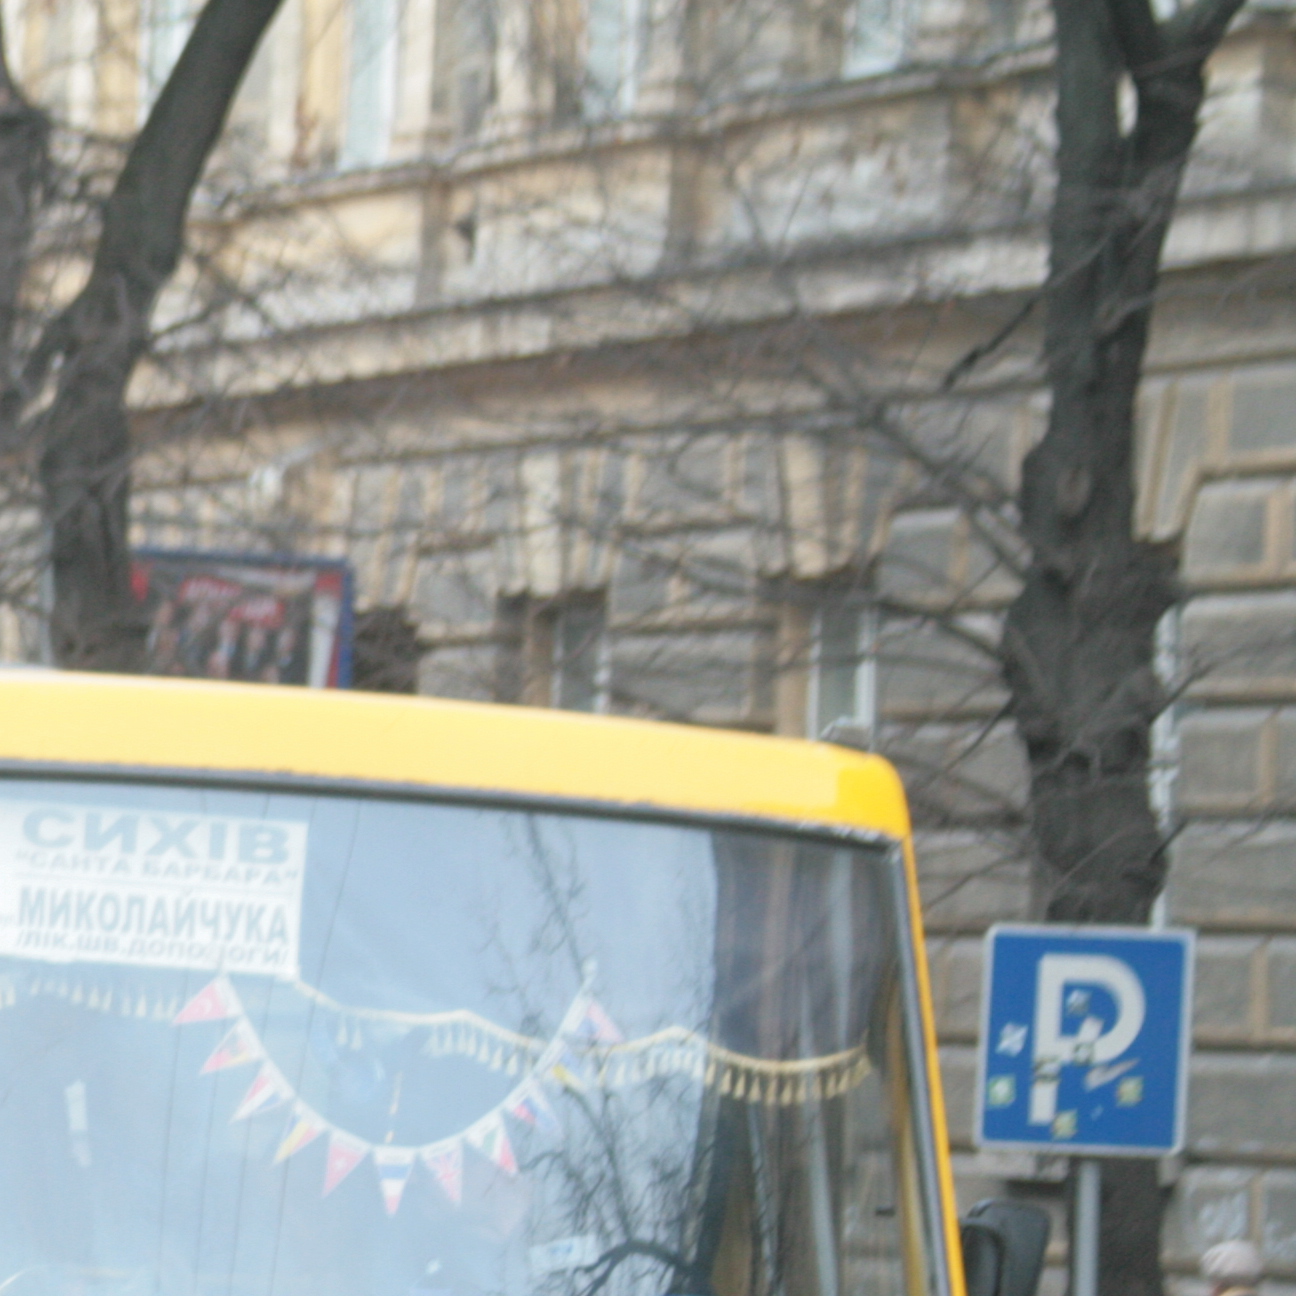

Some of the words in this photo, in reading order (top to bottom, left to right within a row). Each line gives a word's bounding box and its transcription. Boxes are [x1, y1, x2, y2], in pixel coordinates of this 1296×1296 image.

[22, 808, 290, 865] СИХІВ
[18, 885, 290, 946] МИКОЛАЙЧУКА
[1028, 952, 1145, 1126] P
